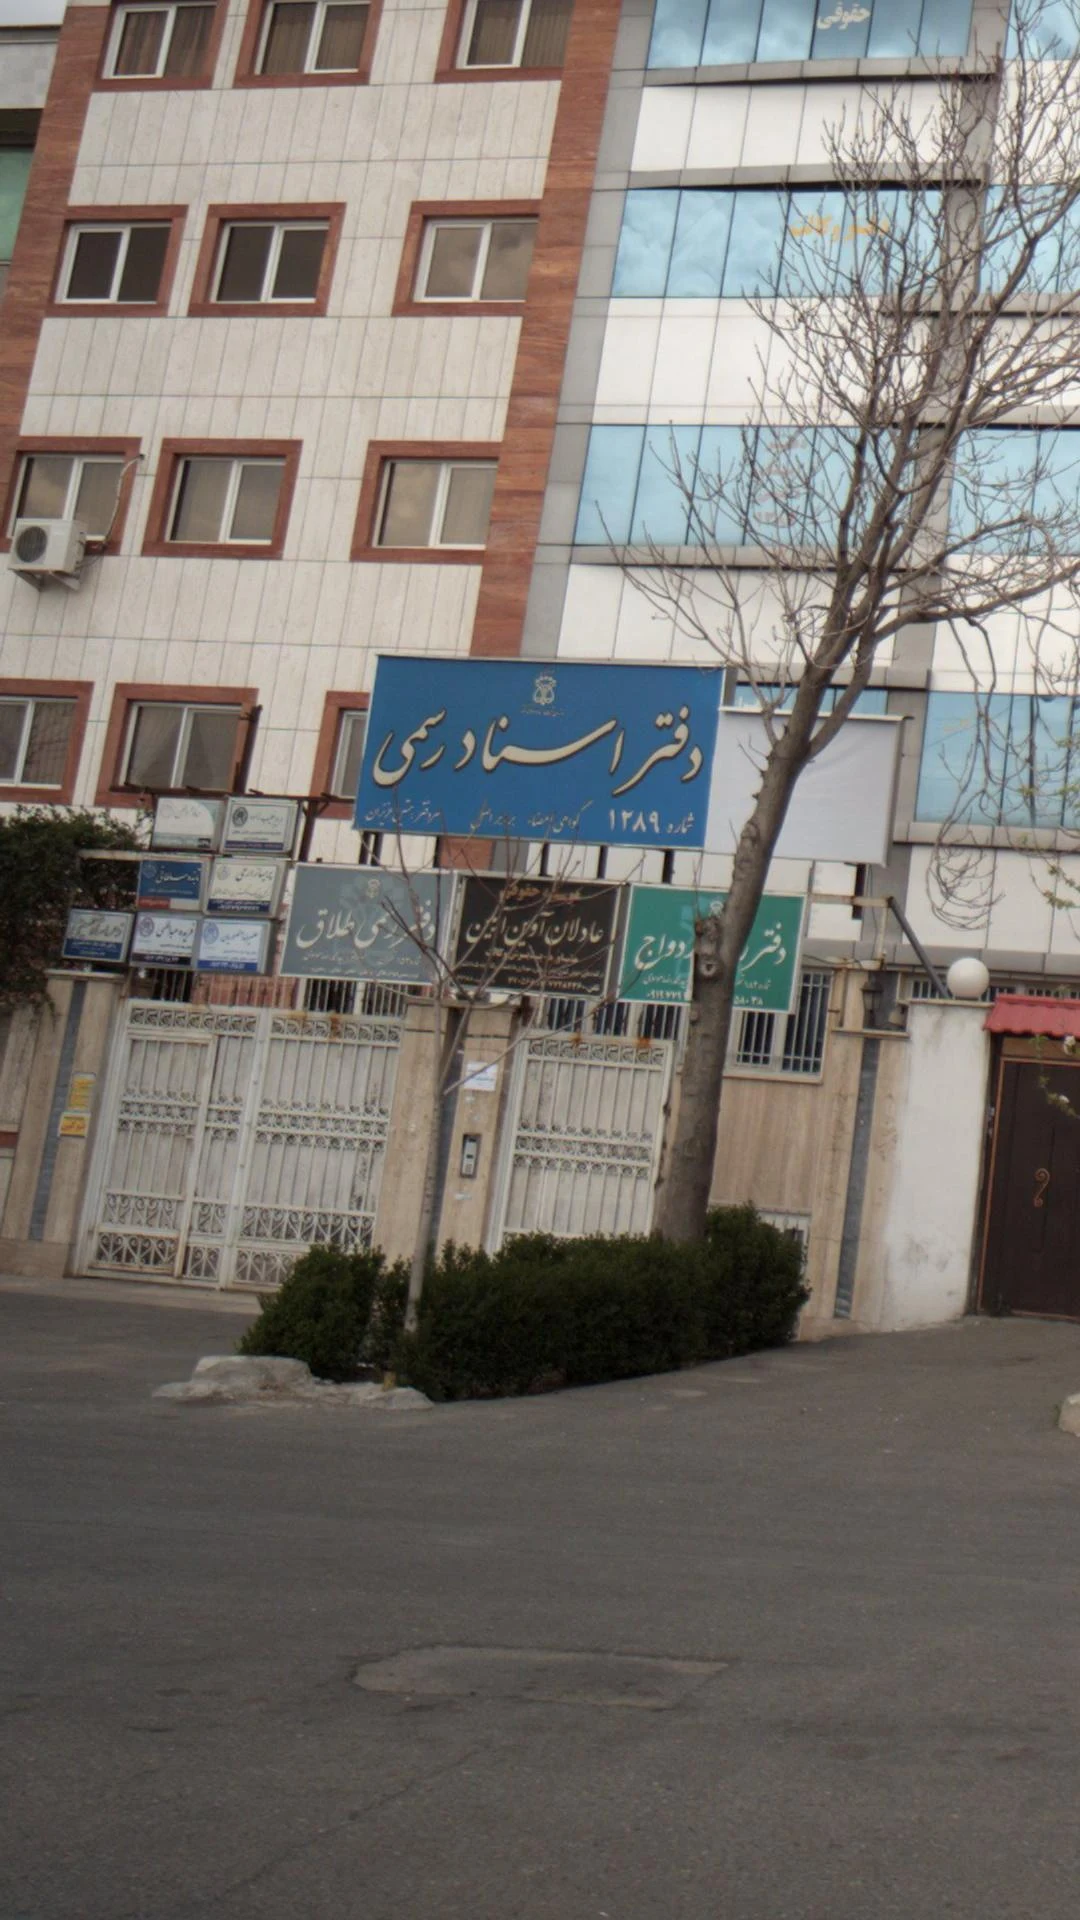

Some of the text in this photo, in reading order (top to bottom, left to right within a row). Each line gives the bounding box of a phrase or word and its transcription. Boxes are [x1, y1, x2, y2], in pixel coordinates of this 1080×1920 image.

[816, 2, 870, 30] حقوقی
[372, 704, 703, 796] دفتر اسناد رسمی
[666, 811, 695, 834] شماره
[296, 908, 355, 949] طلاق
[544, 916, 604, 946] عادلان
[740, 922, 787, 972] دفتر
